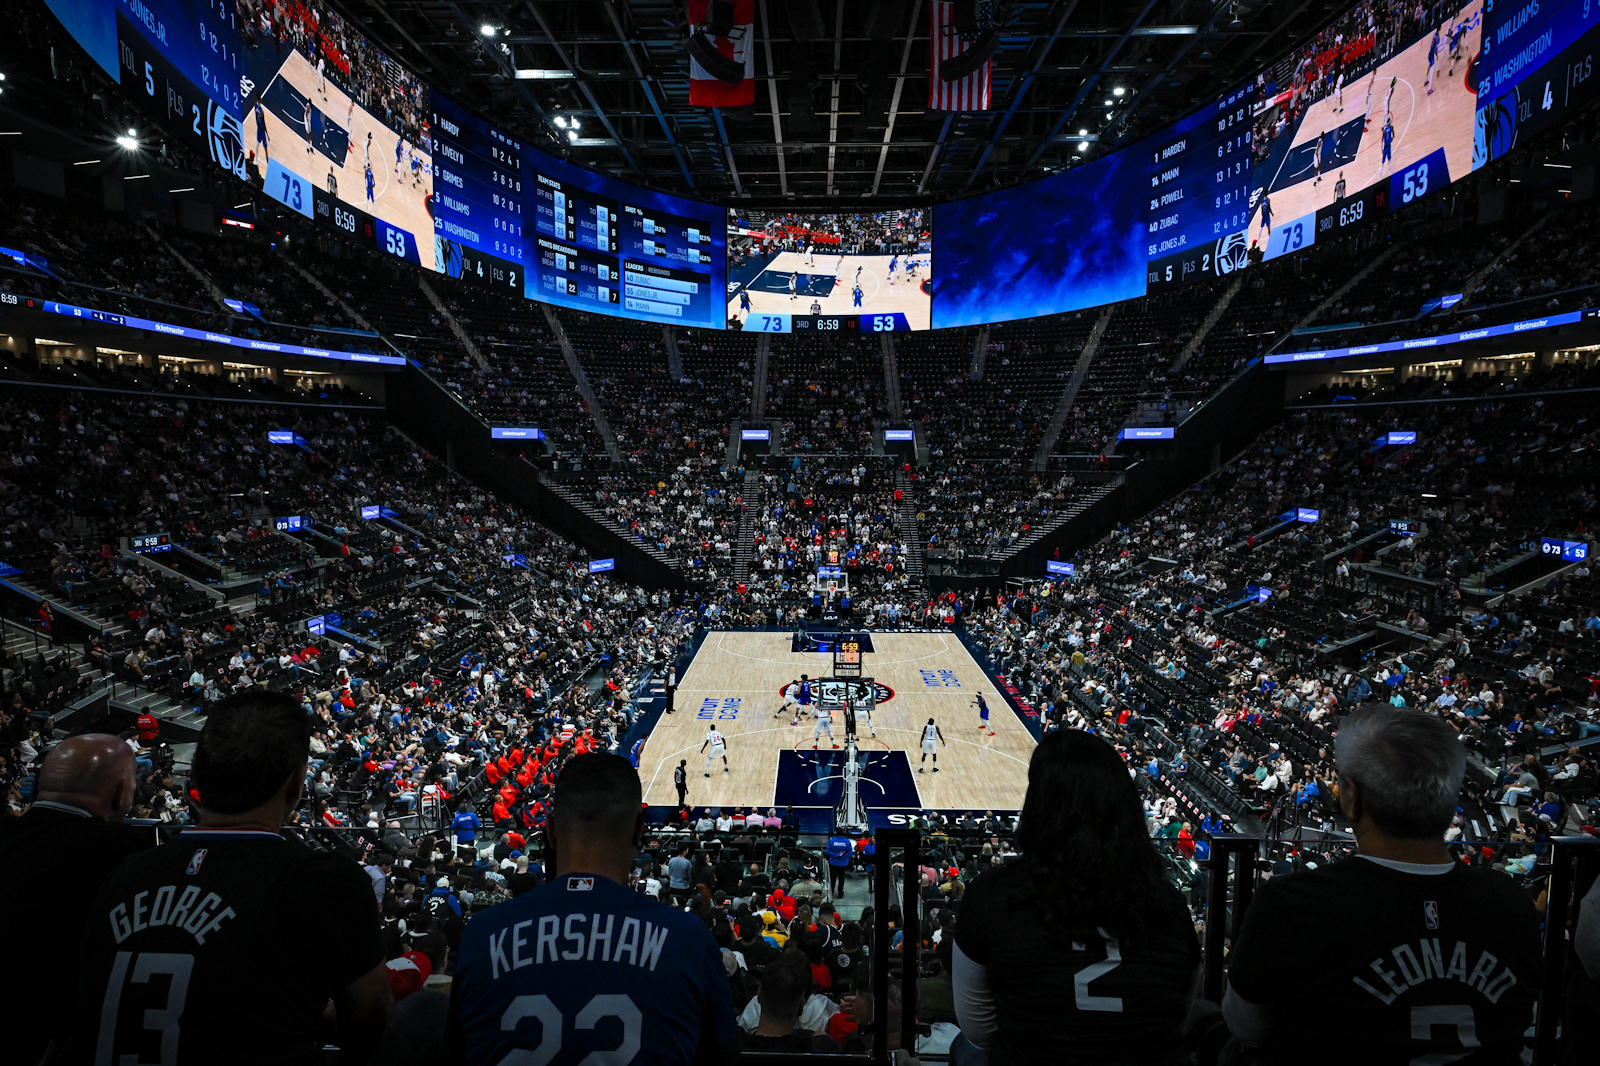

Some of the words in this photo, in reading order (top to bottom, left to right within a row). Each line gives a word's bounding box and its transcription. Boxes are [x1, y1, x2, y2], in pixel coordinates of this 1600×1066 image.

[130, 0, 156, 34] JONES
[156, 21, 168, 47] JR.
[220, 2, 225, 19] 3
[231, 13, 235, 29] 1
[1484, 36, 1491, 55] 5
[1497, 0, 1540, 45] WILLIAMS
[200, 22, 206, 41] 9
[209, 32, 218, 53] 12
[222, 44, 226, 60] 1
[231, 53, 236, 69] 1
[1478, 76, 1491, 99] 25
[1494, 28, 1553, 87] WASHINGTON
[120, 40, 137, 76] TOL
[145, 61, 155, 96] 5
[169, 86, 184, 116] FLS
[192, 104, 201, 136] 2
[201, 64, 210, 86] 12
[233, 92, 239, 110] 2
[1542, 80, 1553, 111] 4
[1573, 54, 1592, 87] FLS
[433, 113, 437, 124] 1
[441, 118, 460, 137] HARDY
[1154, 153, 1158, 163] 1
[1162, 140, 1186, 160] HARDEN
[1218, 119, 1226, 132] 10
[1228, 115, 1233, 127] 2
[1237, 109, 1244, 121] 12
[1248, 104, 1252, 115] 1
[433, 140, 439, 151] 2
[442, 144, 460, 163] LIVELY
[1161, 167, 1180, 183] MANN
[1218, 146, 1223, 157] 6
[1227, 141, 1232, 153] 2
[1237, 136, 1241, 148] 1
[1246, 131, 1251, 143] 0
[435, 165, 440, 177] 5
[442, 169, 463, 189] GRIMES
[1150, 199, 1159, 211] 24
[1160, 188, 1184, 206] POWELL
[1216, 171, 1224, 182] 13
[1227, 167, 1231, 178] 1
[1235, 162, 1241, 174] 3
[1402, 163, 1428, 203] 53
[281, 172, 302, 211] 73
[493, 194, 499, 205] 10
[435, 192, 440, 203] 5
[443, 195, 470, 216] WILLIAMS
[1149, 221, 1158, 233] 40
[1159, 214, 1179, 230] ZUBAC
[1215, 197, 1221, 208] 9
[1223, 193, 1231, 205] 12
[1234, 189, 1238, 200] 1
[1243, 185, 1247, 197] 1
[316, 199, 330, 218] 3RD
[335, 206, 356, 233] 6:59
[364, 223, 372, 238] 18
[1319, 215, 1334, 233] 3RD
[1339, 200, 1364, 227] 6:59
[434, 216, 443, 229] 25
[444, 220, 479, 244] WASHINGTON
[1148, 244, 1157, 256] 55
[1158, 237, 1178, 253] JONES
[1177, 234, 1187, 246] JR.
[1213, 221, 1221, 233] 12
[1223, 219, 1228, 230] 4
[1232, 215, 1238, 226] 0
[1241, 211, 1246, 223] 2
[1282, 222, 1303, 253] 73
[386, 227, 406, 258] 53
[538, 238, 553, 249] POINTS
[552, 243, 578, 257] BREAKDOWN
[477, 261, 484, 278] 4
[493, 268, 504, 281] FLS
[509, 271, 516, 288] 2
[610, 271, 618, 281] 22
[625, 262, 644, 272] LEADERS
[647, 266, 671, 277] REBOUNDS
[1148, 272, 1160, 283] TOL
[1165, 265, 1173, 281] 5
[1183, 261, 1196, 274] FLS
[1202, 253, 1210, 271] 2
[568, 284, 576, 293] 22
[634, 275, 651, 286] ZUBAC
[690, 285, 697, 293] 12
[634, 289, 651, 299] JONES
[1, 293, 17, 305] 6:59
[73, 308, 82, 317] 53
[612, 293, 617, 302] 7
[627, 300, 634, 309] 14
[635, 302, 650, 311] MANN
[675, 307, 680, 315] 2
[155, 323, 185, 335] ticketmaster
[762, 316, 782, 332] 73
[796, 320, 810, 329] 3RD
[817, 319, 839, 330] 6:59
[847, 320, 856, 329] 18
[873, 315, 895, 332] 53
[1459, 329, 1489, 341] ticketmaster
[1513, 319, 1548, 331] ticketmaster
[206, 332, 231, 343] ticketmaster
[251, 341, 281, 351] ticketmaster
[1404, 338, 1438, 348] ticketmaster
[303, 348, 330, 357] ticketmaster
[350, 354, 380, 362] ticketmaster
[1294, 352, 1326, 360] ticketmaster
[1349, 345, 1379, 355] ticketmaster
[1551, 545, 1561, 555] 73
[1575, 548, 1585, 558] 53
[697, 698, 720, 719] INTUIT
[718, 698, 742, 720] DOME
[109, 885, 236, 945] GEORGE
[489, 913, 669, 980] KERSHAW
[1072, 926, 1123, 1012] 2
[1352, 938, 1517, 1005] LEONARD
[94, 951, 195, 1066] 13
[496, 994, 643, 1066] 22
